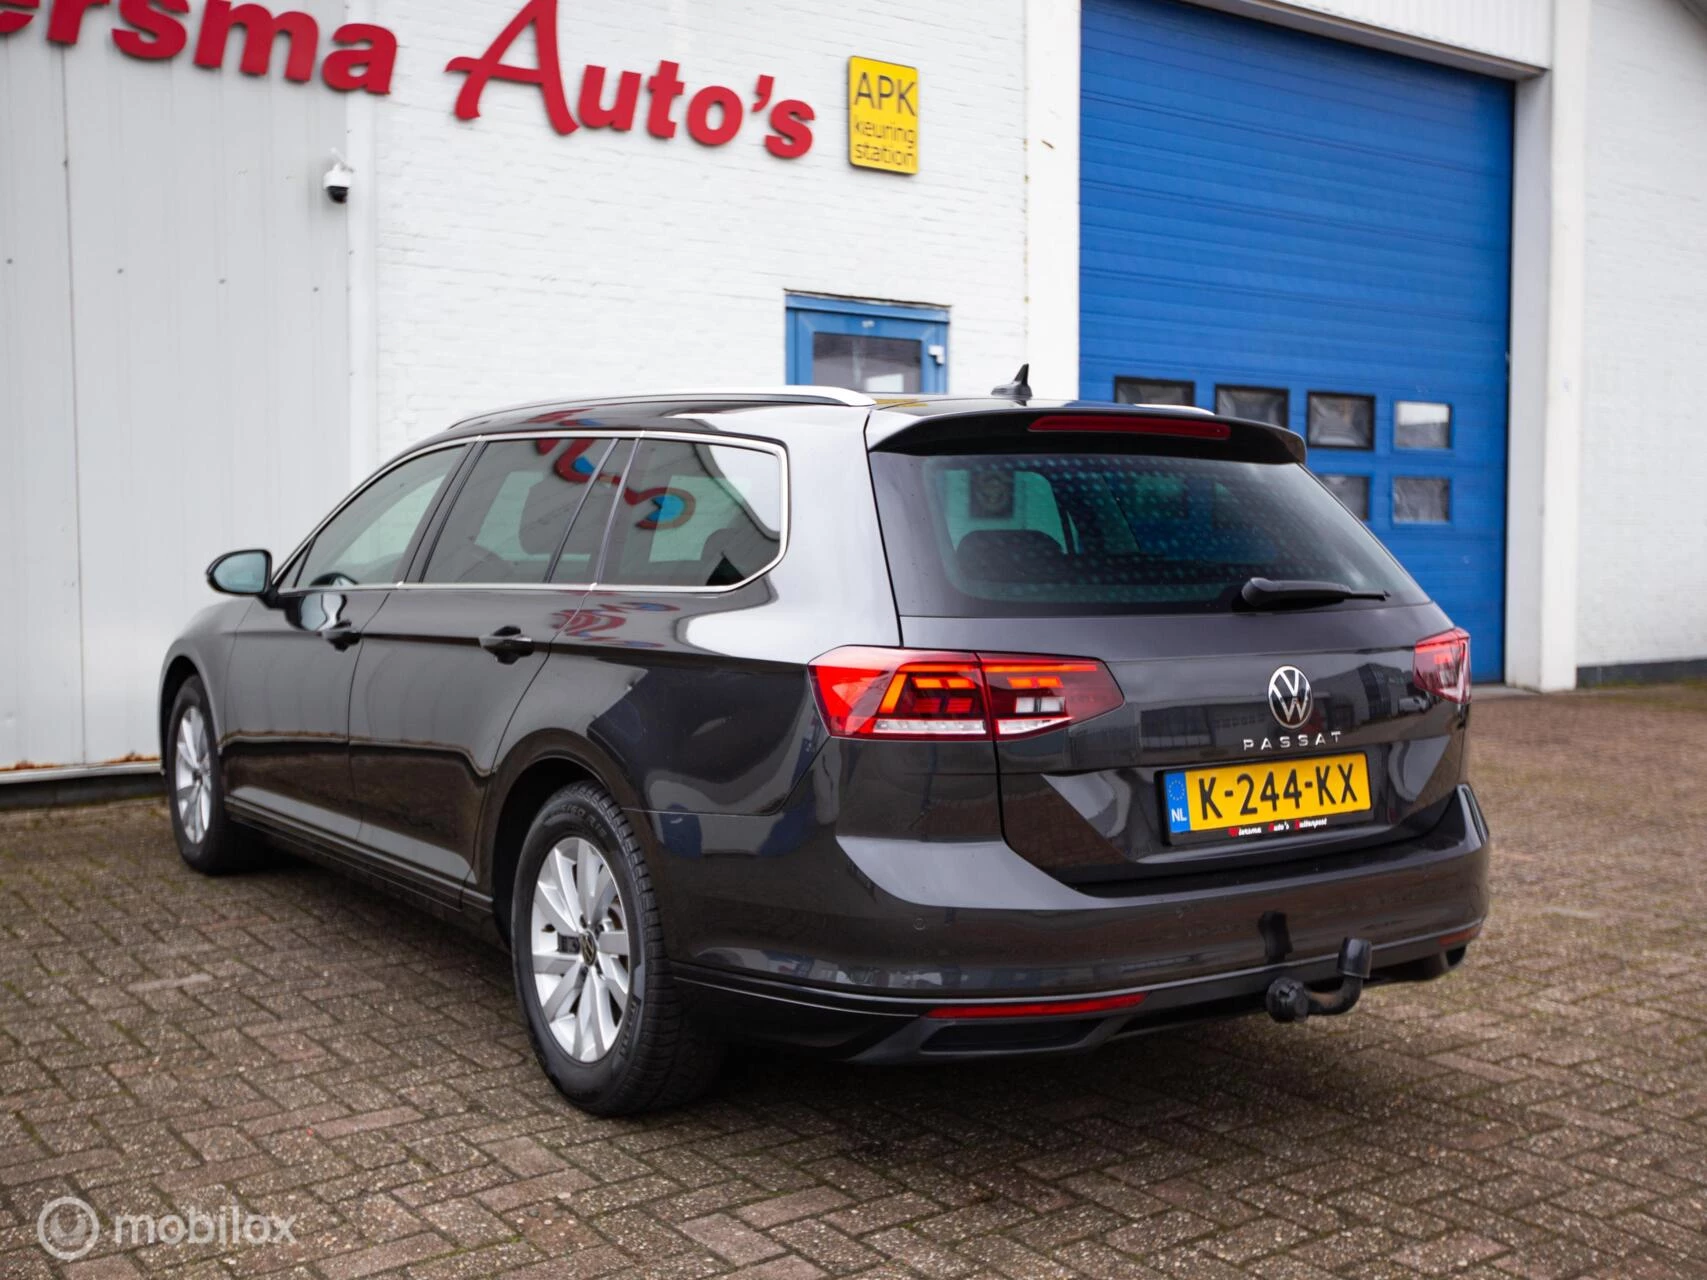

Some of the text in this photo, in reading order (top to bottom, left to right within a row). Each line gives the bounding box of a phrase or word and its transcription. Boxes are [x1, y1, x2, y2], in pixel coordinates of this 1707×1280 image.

[445, 0, 815, 159] Auto's
[854, 71, 917, 117] APK
[854, 114, 916, 150] keuring
[855, 142, 916, 168] station
[1243, 730, 1341, 751] PASSAT
[1198, 763, 1358, 821] K-244-KX
[1171, 807, 1187, 823] NL
